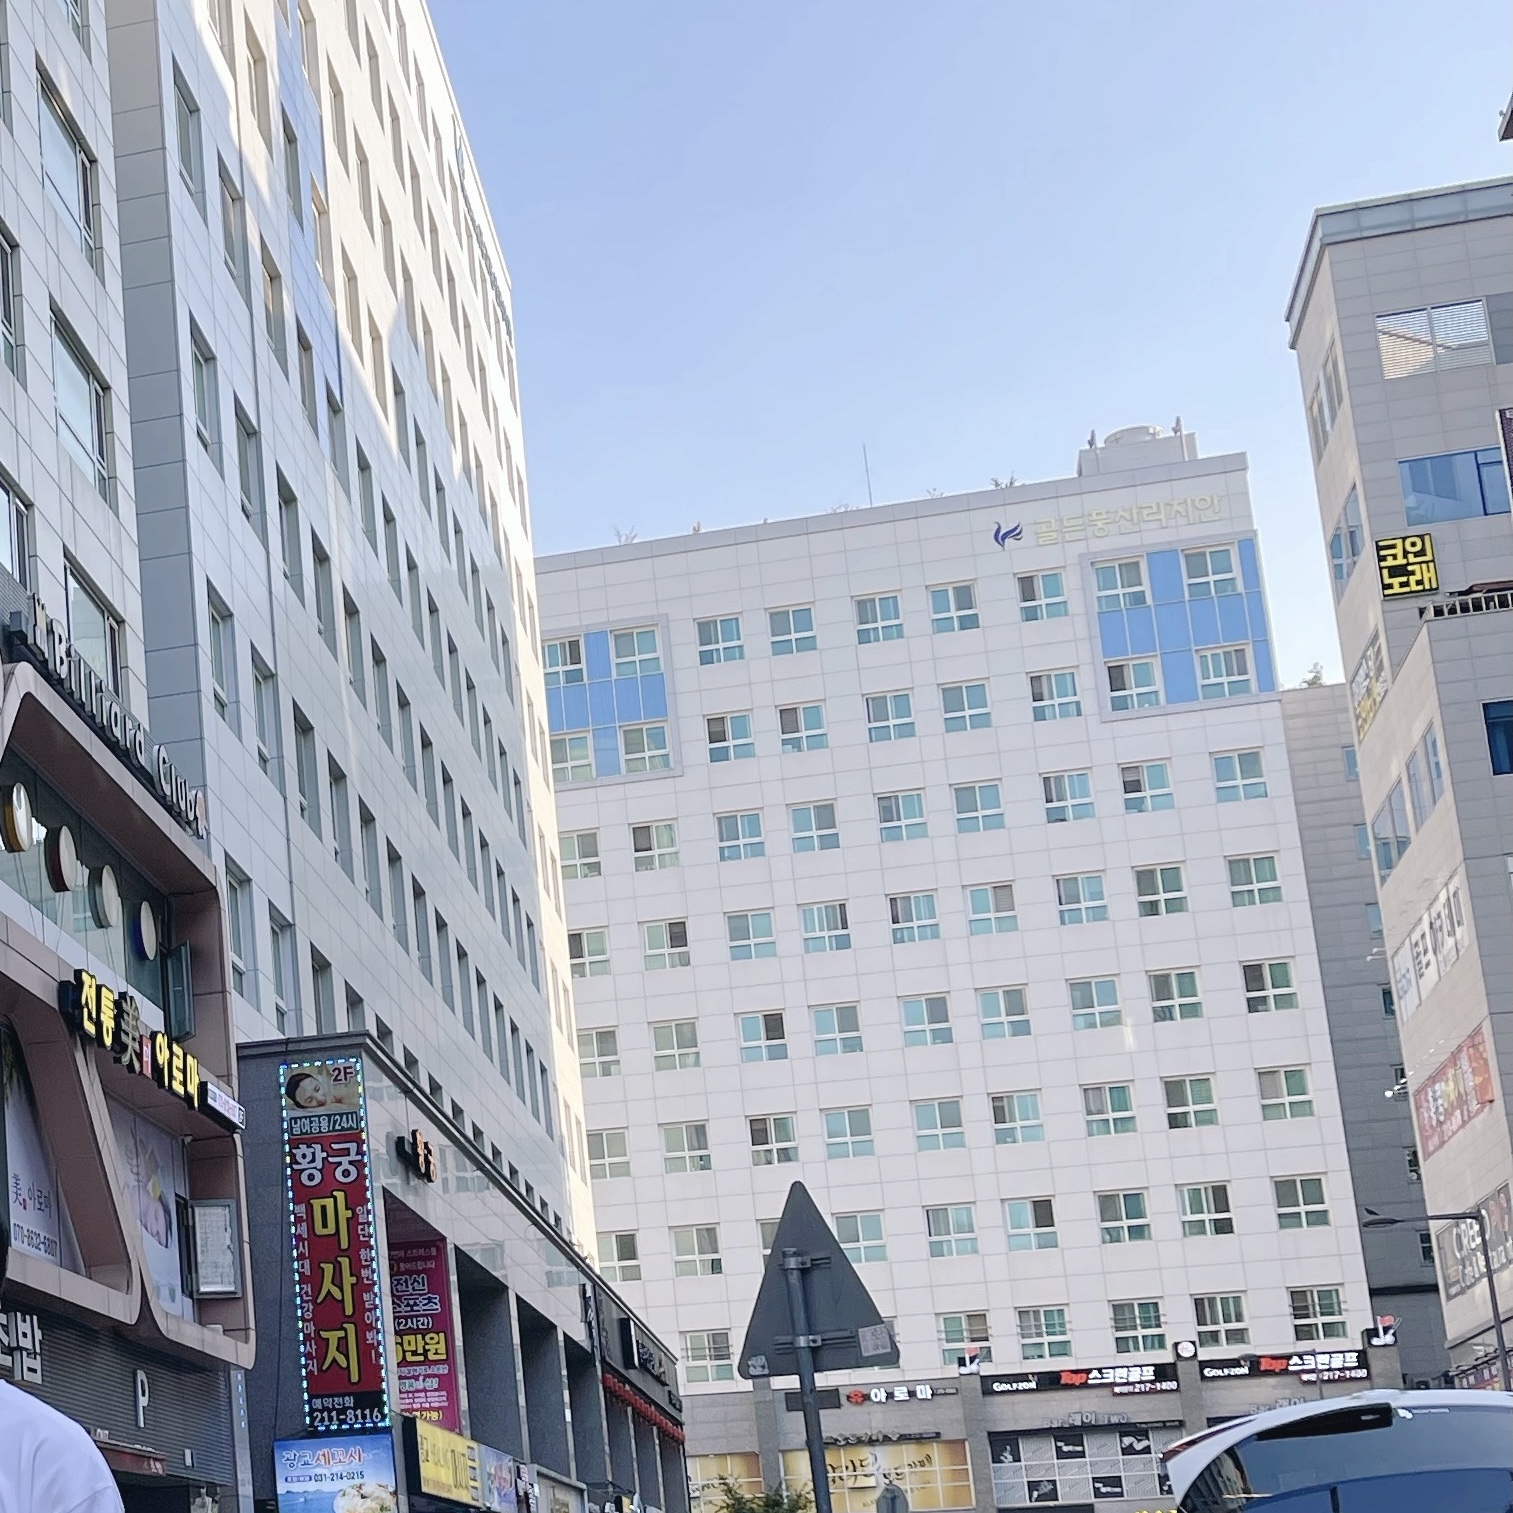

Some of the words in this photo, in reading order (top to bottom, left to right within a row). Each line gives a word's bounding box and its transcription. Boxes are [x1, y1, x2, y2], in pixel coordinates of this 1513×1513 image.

[1378, 535, 1434, 568] 코인
[1382, 561, 1438, 596] 노래
[50, 617, 145, 768] Billiard
[152, 744, 197, 821] Club
[80, 969, 115, 1051] 전통
[155, 1031, 201, 1111] 아로마
[331, 1065, 355, 1084] 2F
[291, 1141, 364, 1188] 황궁
[294, 1203, 312, 1276] 백세시대
[309, 1190, 360, 1385] 마사지
[392, 1275, 428, 1294] 전신
[300, 1282, 318, 1376] 건강마사지
[395, 1317, 433, 1332] (2시간)
[1088, 1366, 1156, 1384] 스크린골프
[1288, 1351, 1359, 1371] 스크린골프
[313, 1409, 382, 1427] 211-8116
[281, 1445, 365, 1471] 광교세꼬시
[313, 1470, 365, 1483] 031-214-0215
